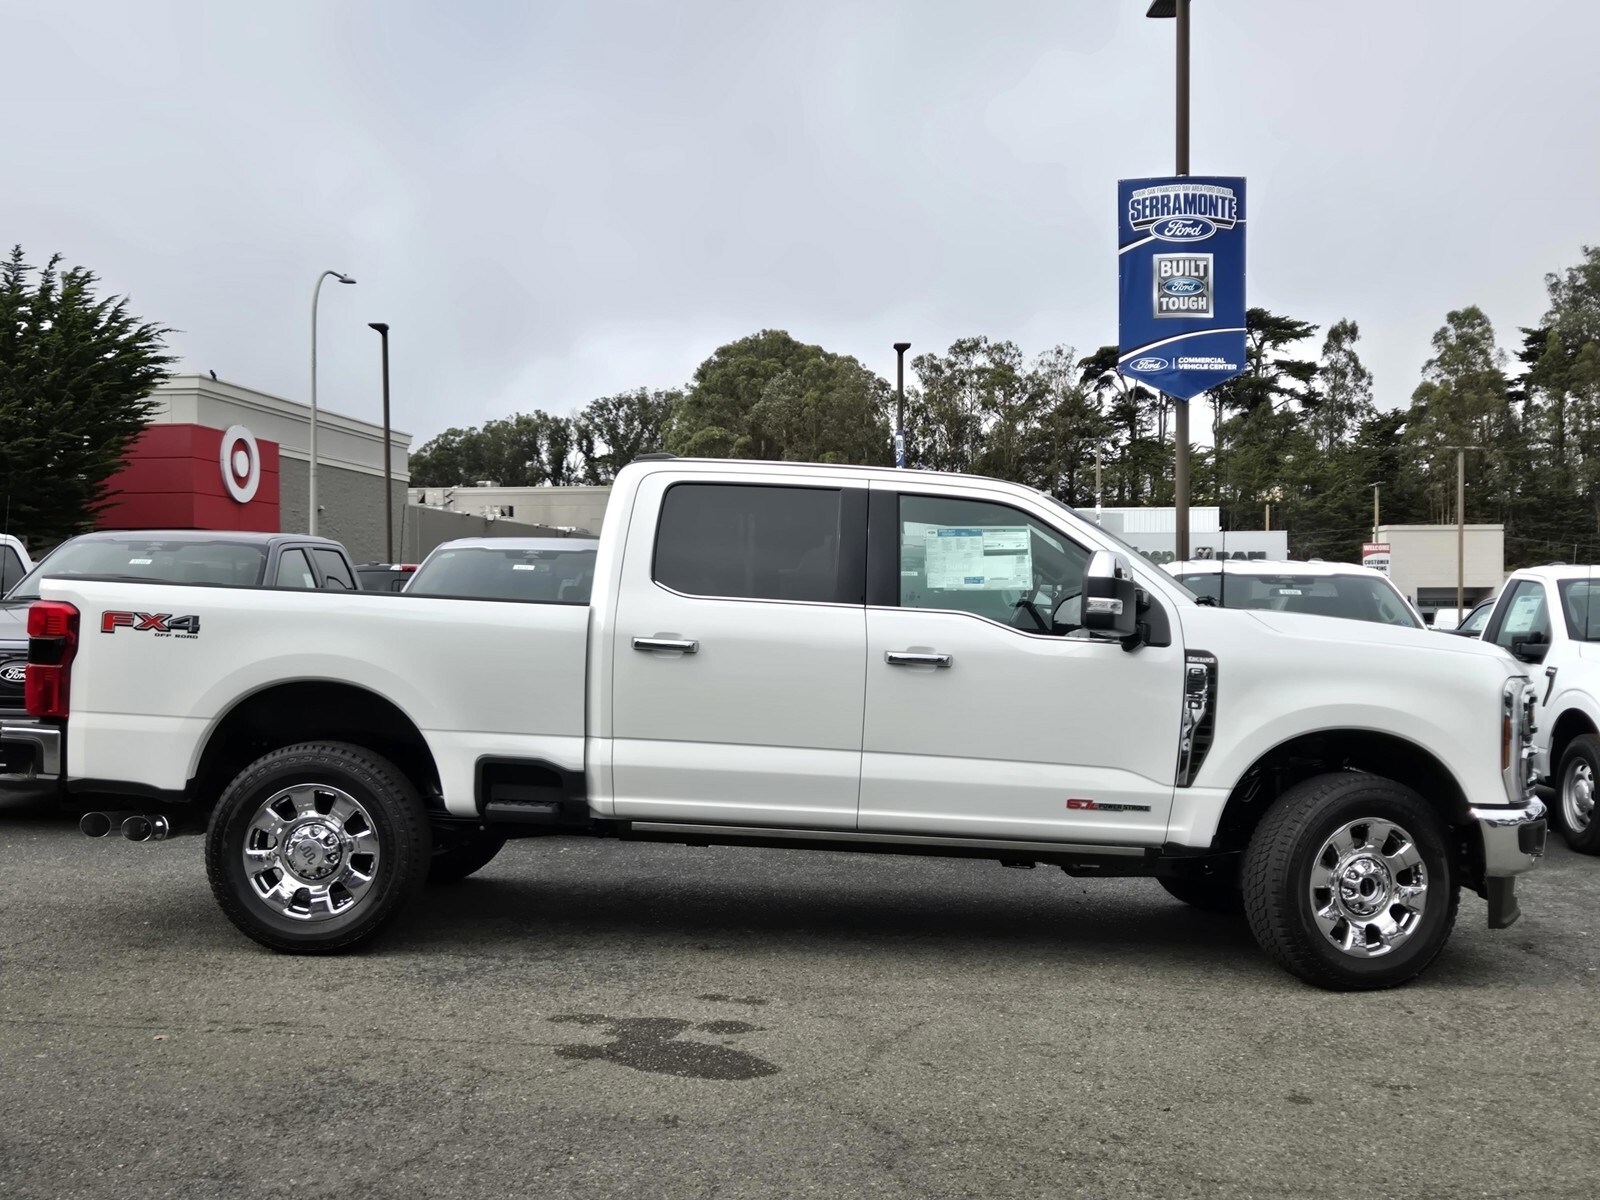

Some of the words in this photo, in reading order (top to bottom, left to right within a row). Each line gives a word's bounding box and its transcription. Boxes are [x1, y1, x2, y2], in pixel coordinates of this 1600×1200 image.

[1147, 188, 1156, 196] SAN
[1157, 186, 1181, 194] FRANCISCO
[1216, 187, 1233, 196] DEALER
[1130, 193, 1236, 221] SERRAMONTE
[1164, 220, 1202, 236] Ford
[1160, 260, 1207, 277] BUILT
[1171, 281, 1195, 291] Ford
[1160, 297, 1207, 310] TOUGH
[1136, 360, 1160, 369] Ford
[1216, 551, 1267, 561] RAM
[101, 610, 200, 634] FX4
[6, 667, 26, 679] For
[1099, 803, 1122, 811] POWER
